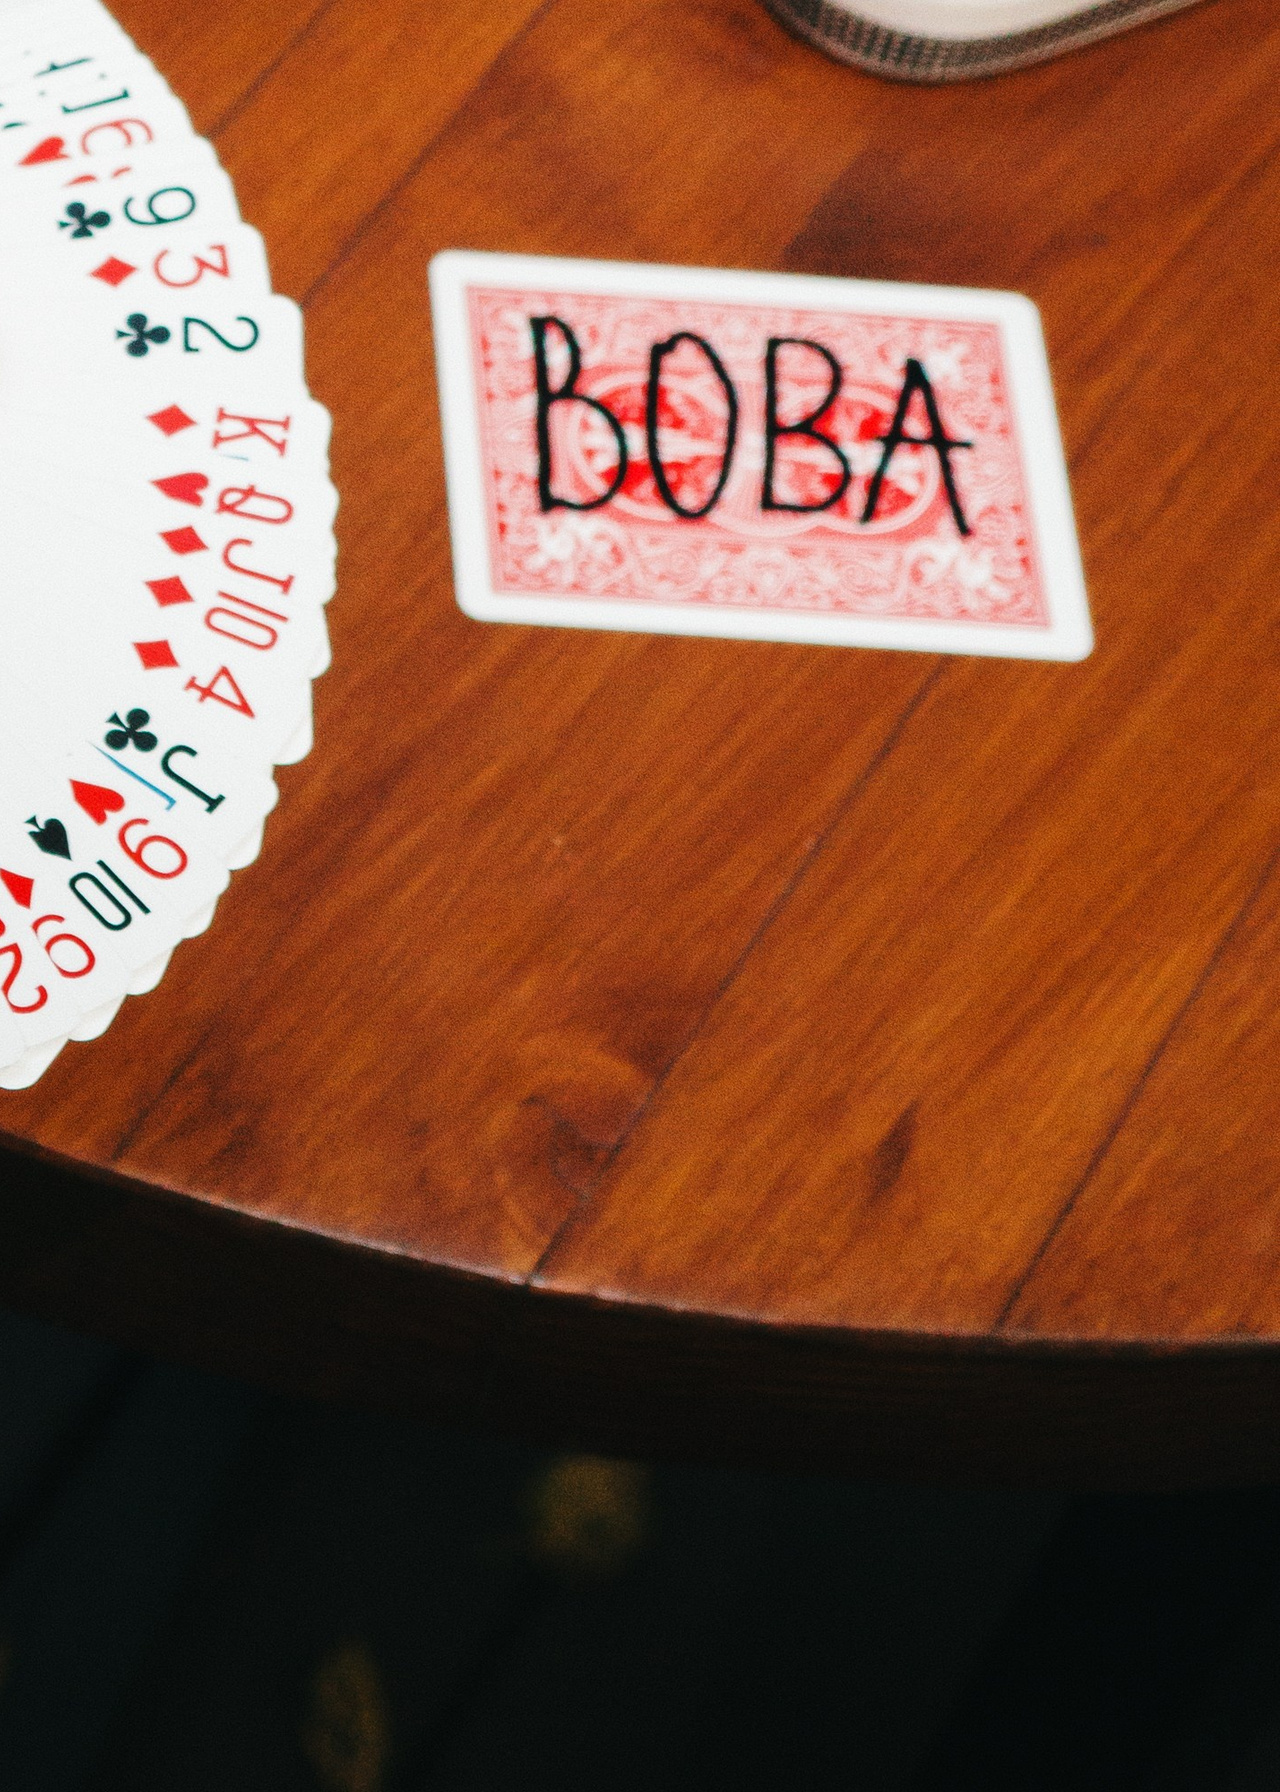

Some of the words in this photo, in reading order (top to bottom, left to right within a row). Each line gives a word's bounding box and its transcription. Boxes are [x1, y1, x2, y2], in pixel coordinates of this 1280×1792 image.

[123, 186, 196, 225] 9
[153, 244, 231, 288] 3
[183, 316, 260, 353] 2
[211, 406, 292, 458] K
[528, 314, 976, 538] BOBA
[214, 484, 295, 525] Q
[222, 537, 296, 596] J
[203, 590, 290, 651] 10
[184, 665, 256, 719] 4
[160, 744, 226, 814] J
[117, 817, 190, 880] 9
[68, 859, 152, 932] 10
